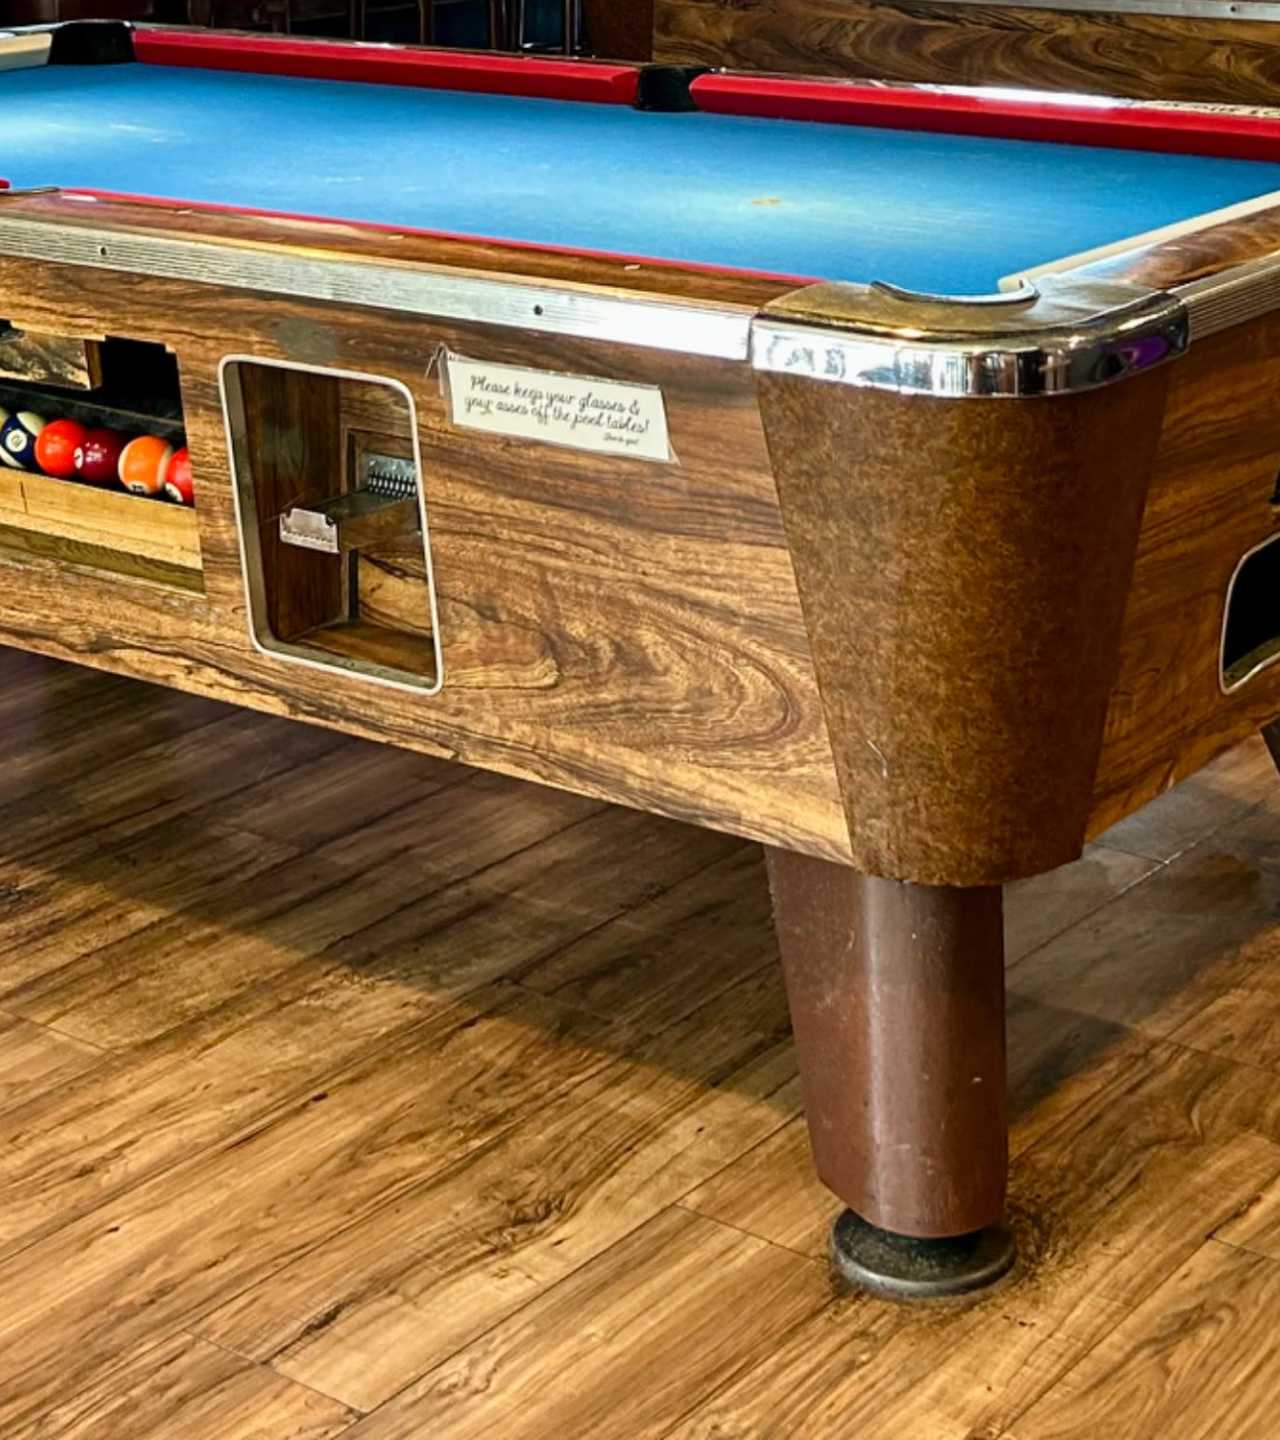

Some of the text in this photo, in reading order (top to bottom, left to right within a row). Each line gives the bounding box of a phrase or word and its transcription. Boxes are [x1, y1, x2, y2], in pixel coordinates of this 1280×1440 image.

[470, 375, 511, 395] Please
[513, 381, 544, 402] keep
[546, 391, 574, 407] your
[578, 392, 626, 413] glasses
[495, 400, 528, 415] asses
[530, 404, 550, 426] off
[553, 406, 570, 422] the
[571, 413, 604, 429] pool
[606, 413, 650, 434] tables!
